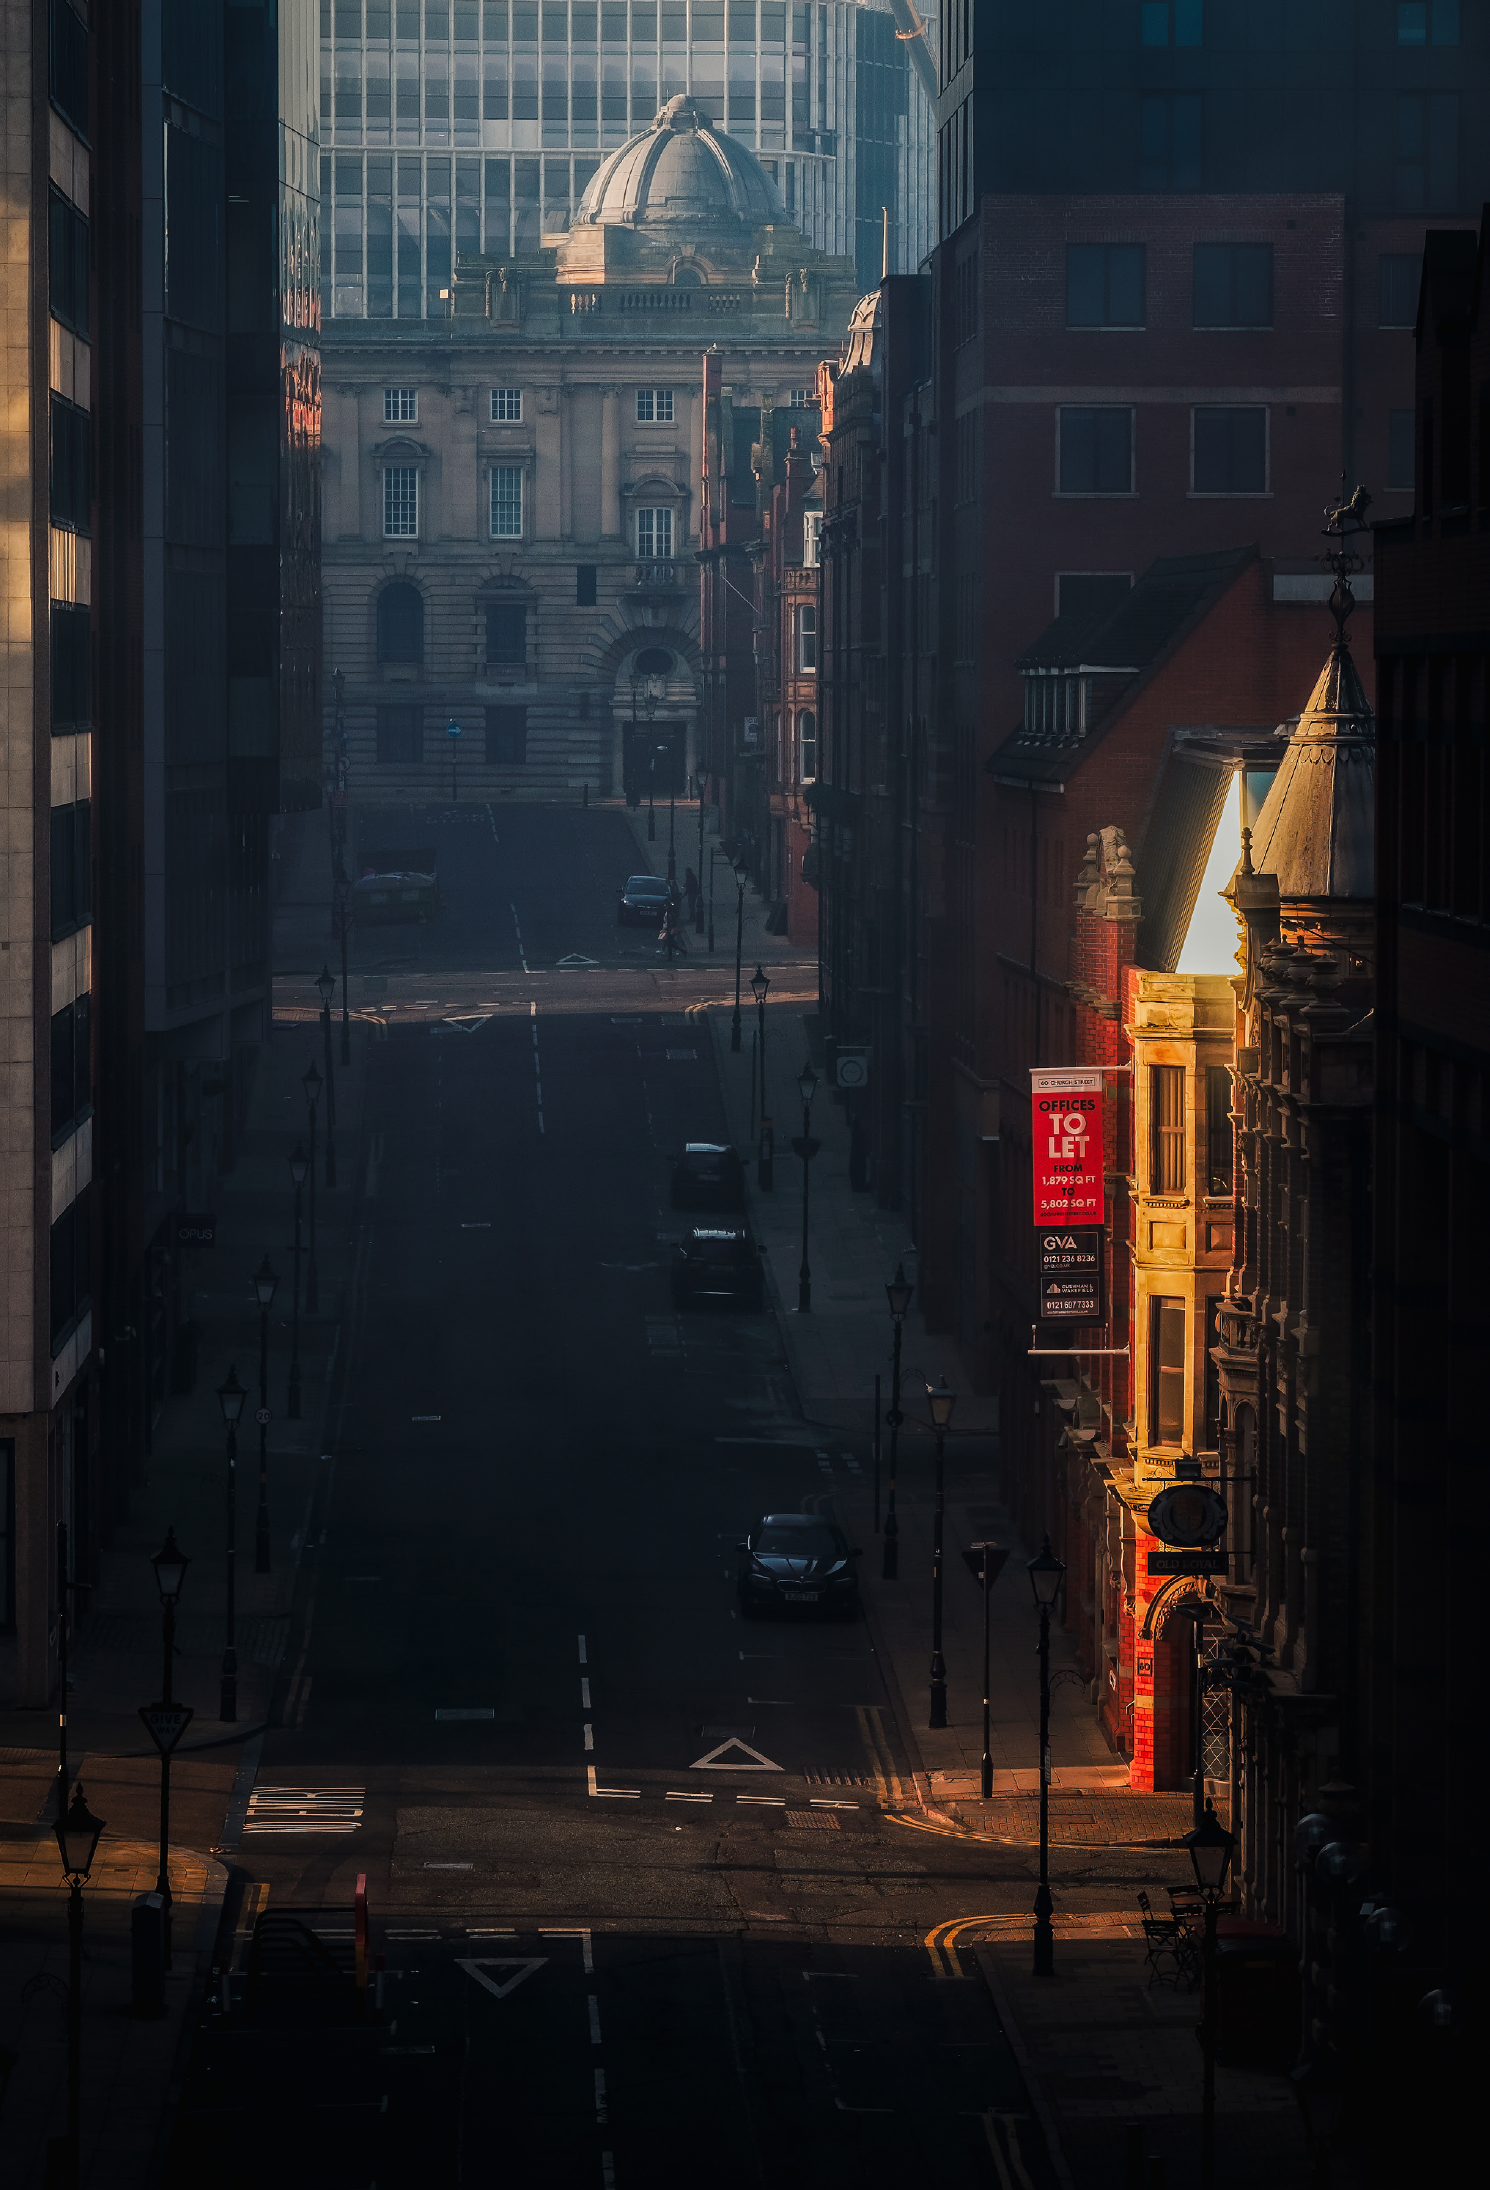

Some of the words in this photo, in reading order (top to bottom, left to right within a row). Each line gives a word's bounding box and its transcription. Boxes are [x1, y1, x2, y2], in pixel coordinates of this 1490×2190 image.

[1039, 1099, 1096, 1112] OFFICES
[1049, 1112, 1087, 1135] TO
[1048, 1135, 1090, 1159] LET
[1053, 1163, 1083, 1173] FROM
[1042, 1175, 1068, 1187] 1,879
[1069, 1175, 1084, 1185] SQ
[1085, 1175, 1096, 1184] FT
[1061, 1187, 1075, 1196] TO
[1040, 1199, 1069, 1210] 5,802
[1070, 1198, 1085, 1208] SQ
[1086, 1198, 1097, 1207] FT
[179, 1228, 213, 1240] OPUS
[1043, 1235, 1078, 1250] GVA
[1043, 1255, 1060, 1263] 0121
[1076, 1254, 1096, 1262] 8236
[1046, 1301, 1063, 1309] 0121
[1064, 1301, 1077, 1309] 697
[1077, 1300, 1094, 1308] 7333
[257, 1412, 270, 1420] 20
[1156, 1559, 1180, 1569] OLD
[1139, 1662, 1151, 1671] 60
[150, 1714, 181, 1724] GIVE
[157, 1726, 177, 1734] WAY
